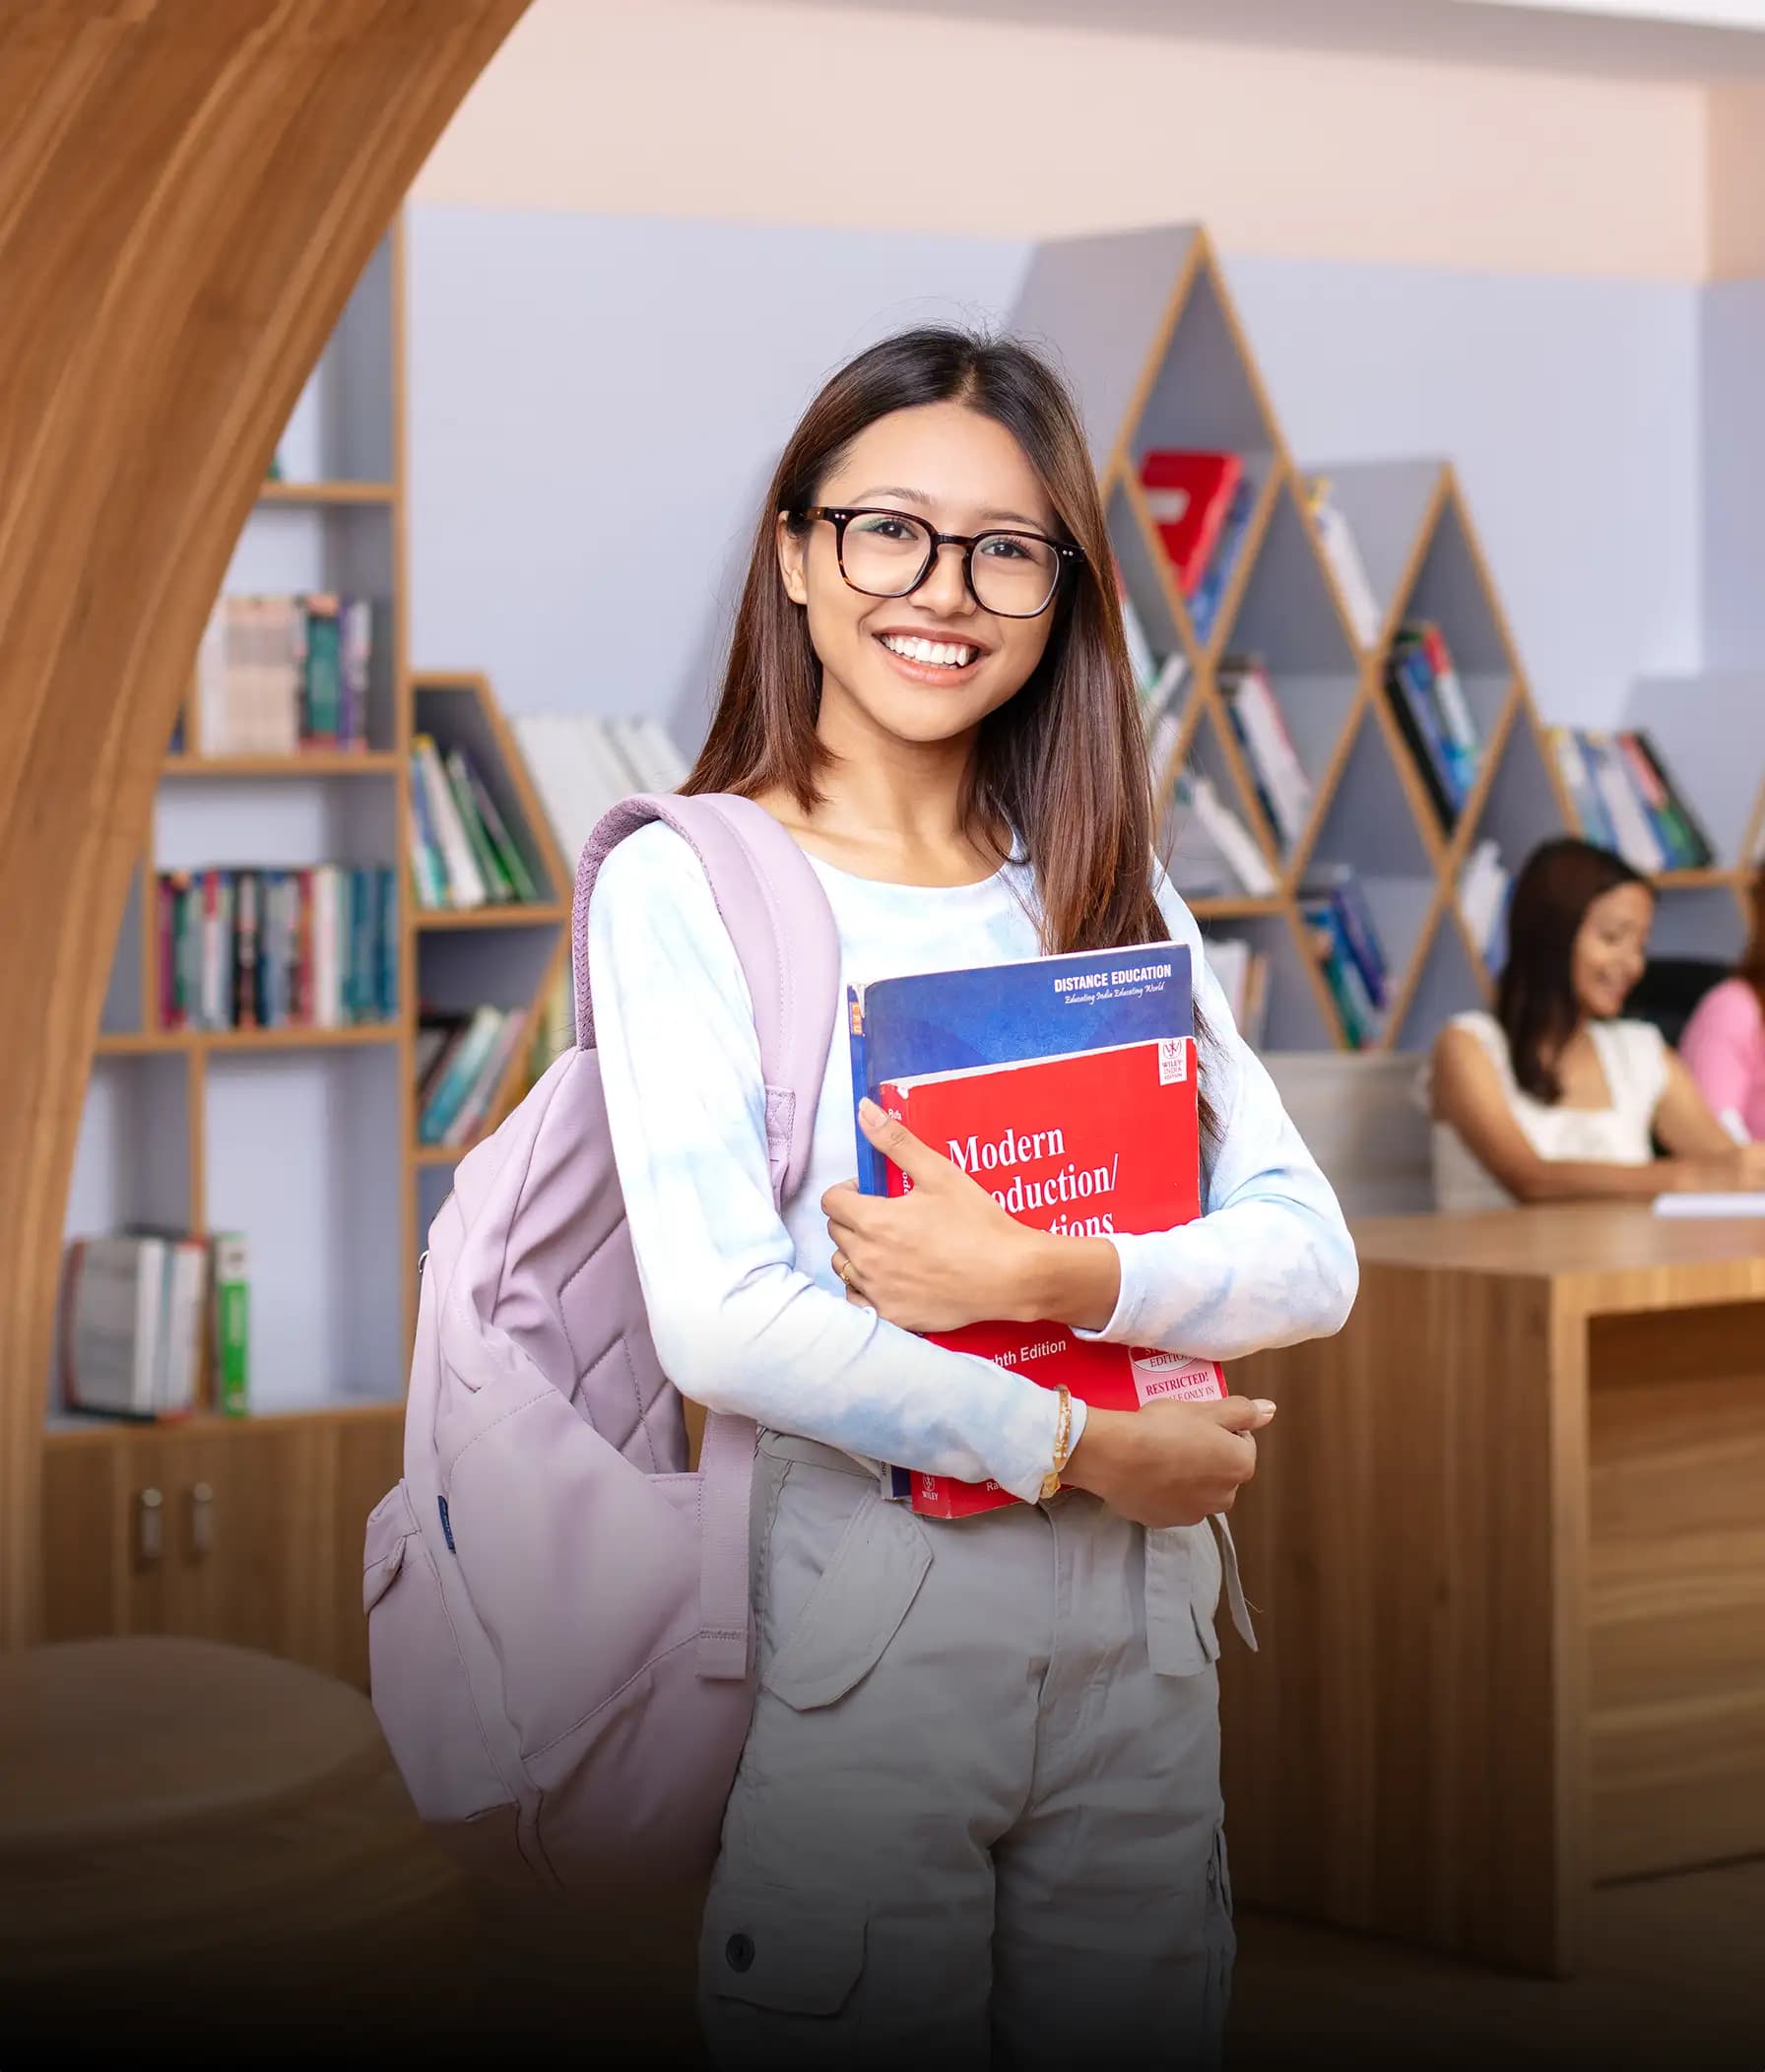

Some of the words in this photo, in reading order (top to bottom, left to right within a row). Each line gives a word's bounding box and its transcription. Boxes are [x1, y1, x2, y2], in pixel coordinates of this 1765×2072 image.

[1054, 973, 1108, 993] DISTANCE
[1111, 964, 1172, 985] EDUCATION
[1065, 994, 1095, 1005] Educating
[1096, 989, 1113, 1001] India
[1114, 987, 1144, 999] Educating
[1144, 981, 1165, 994] World
[1162, 1059, 1183, 1068] WILEY
[946, 1128, 1065, 1174] Modern
[991, 1152, 1119, 1213] oduction/
[1020, 1339, 1067, 1362] Edition
[1149, 1352, 1187, 1368] EDITIO
[1145, 1371, 1209, 1396] RESTRICTED!
[1184, 1388, 1204, 1400] ONLY
[1206, 1386, 1215, 1395] IN
[921, 1490, 938, 1501] WILEY
